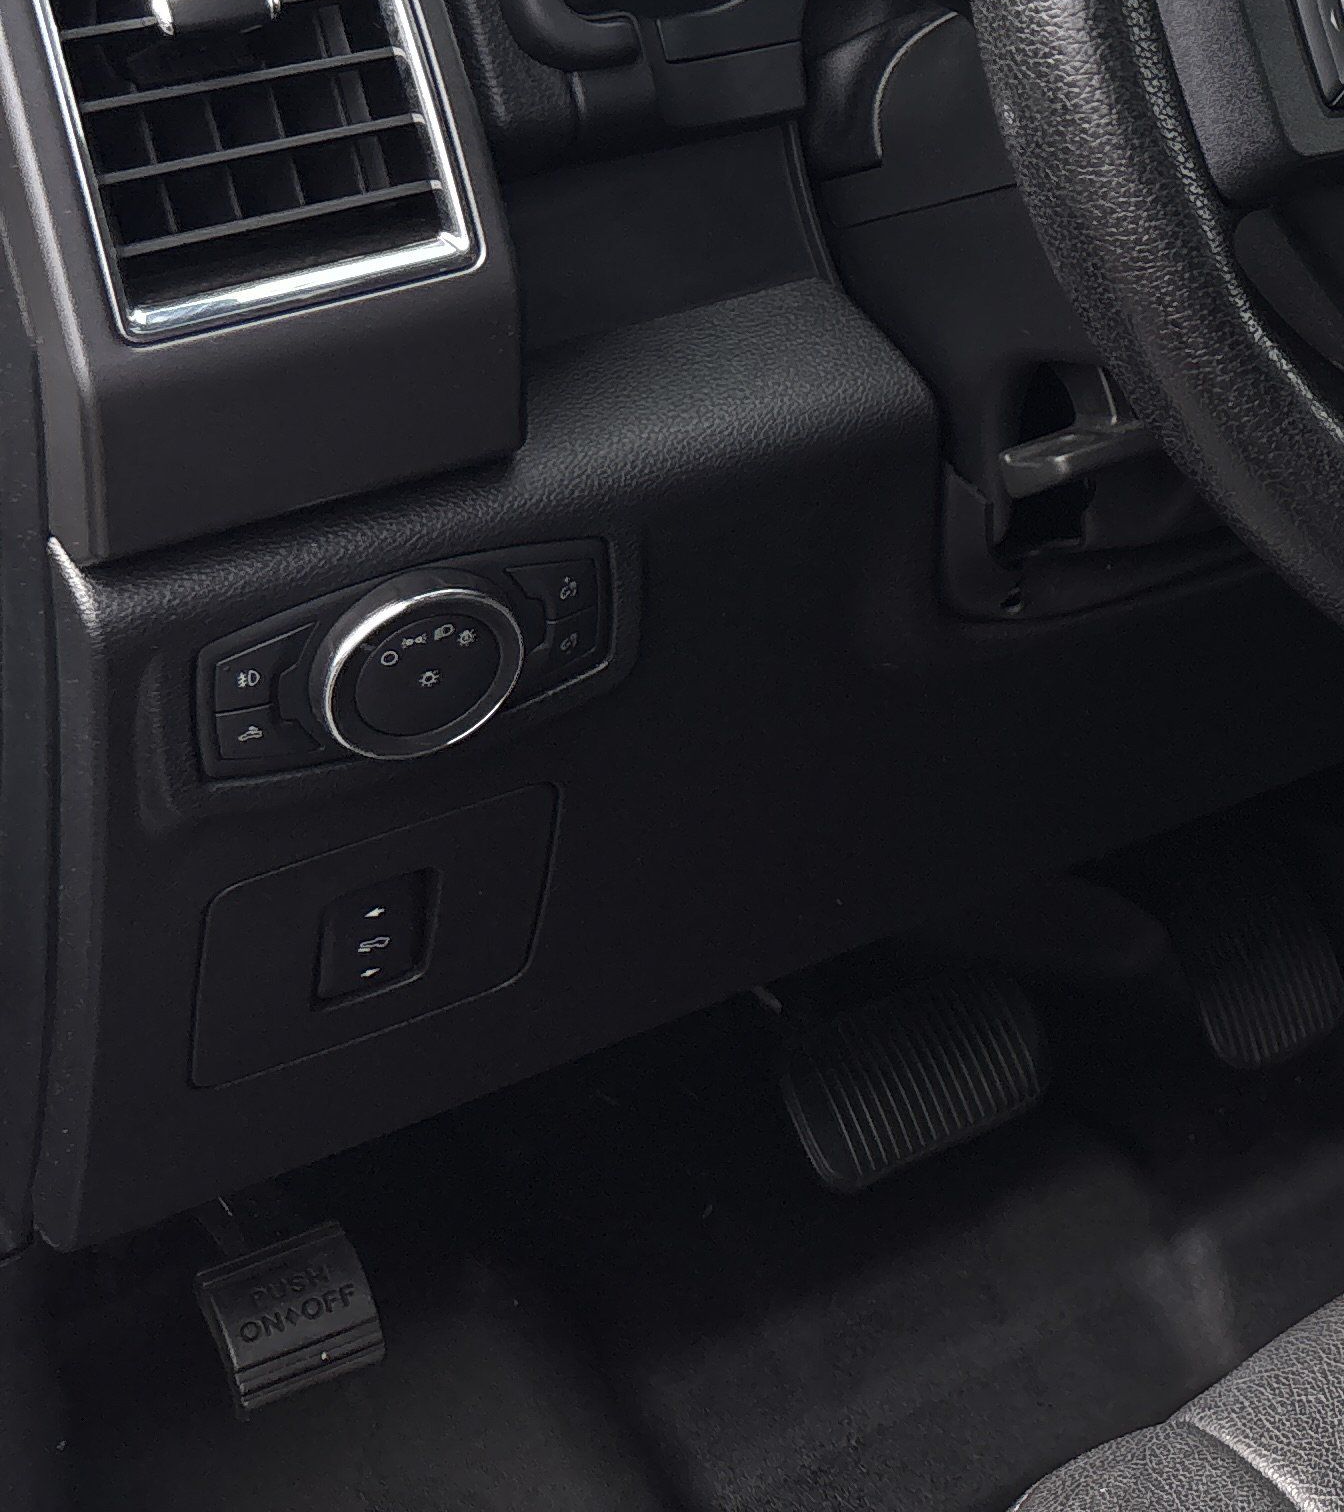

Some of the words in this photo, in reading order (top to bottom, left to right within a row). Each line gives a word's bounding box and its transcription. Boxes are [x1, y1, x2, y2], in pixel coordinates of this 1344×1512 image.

[250, 1263, 331, 1307] PUSH
[239, 1311, 286, 1344] ON
[300, 1282, 355, 1320] OFF
